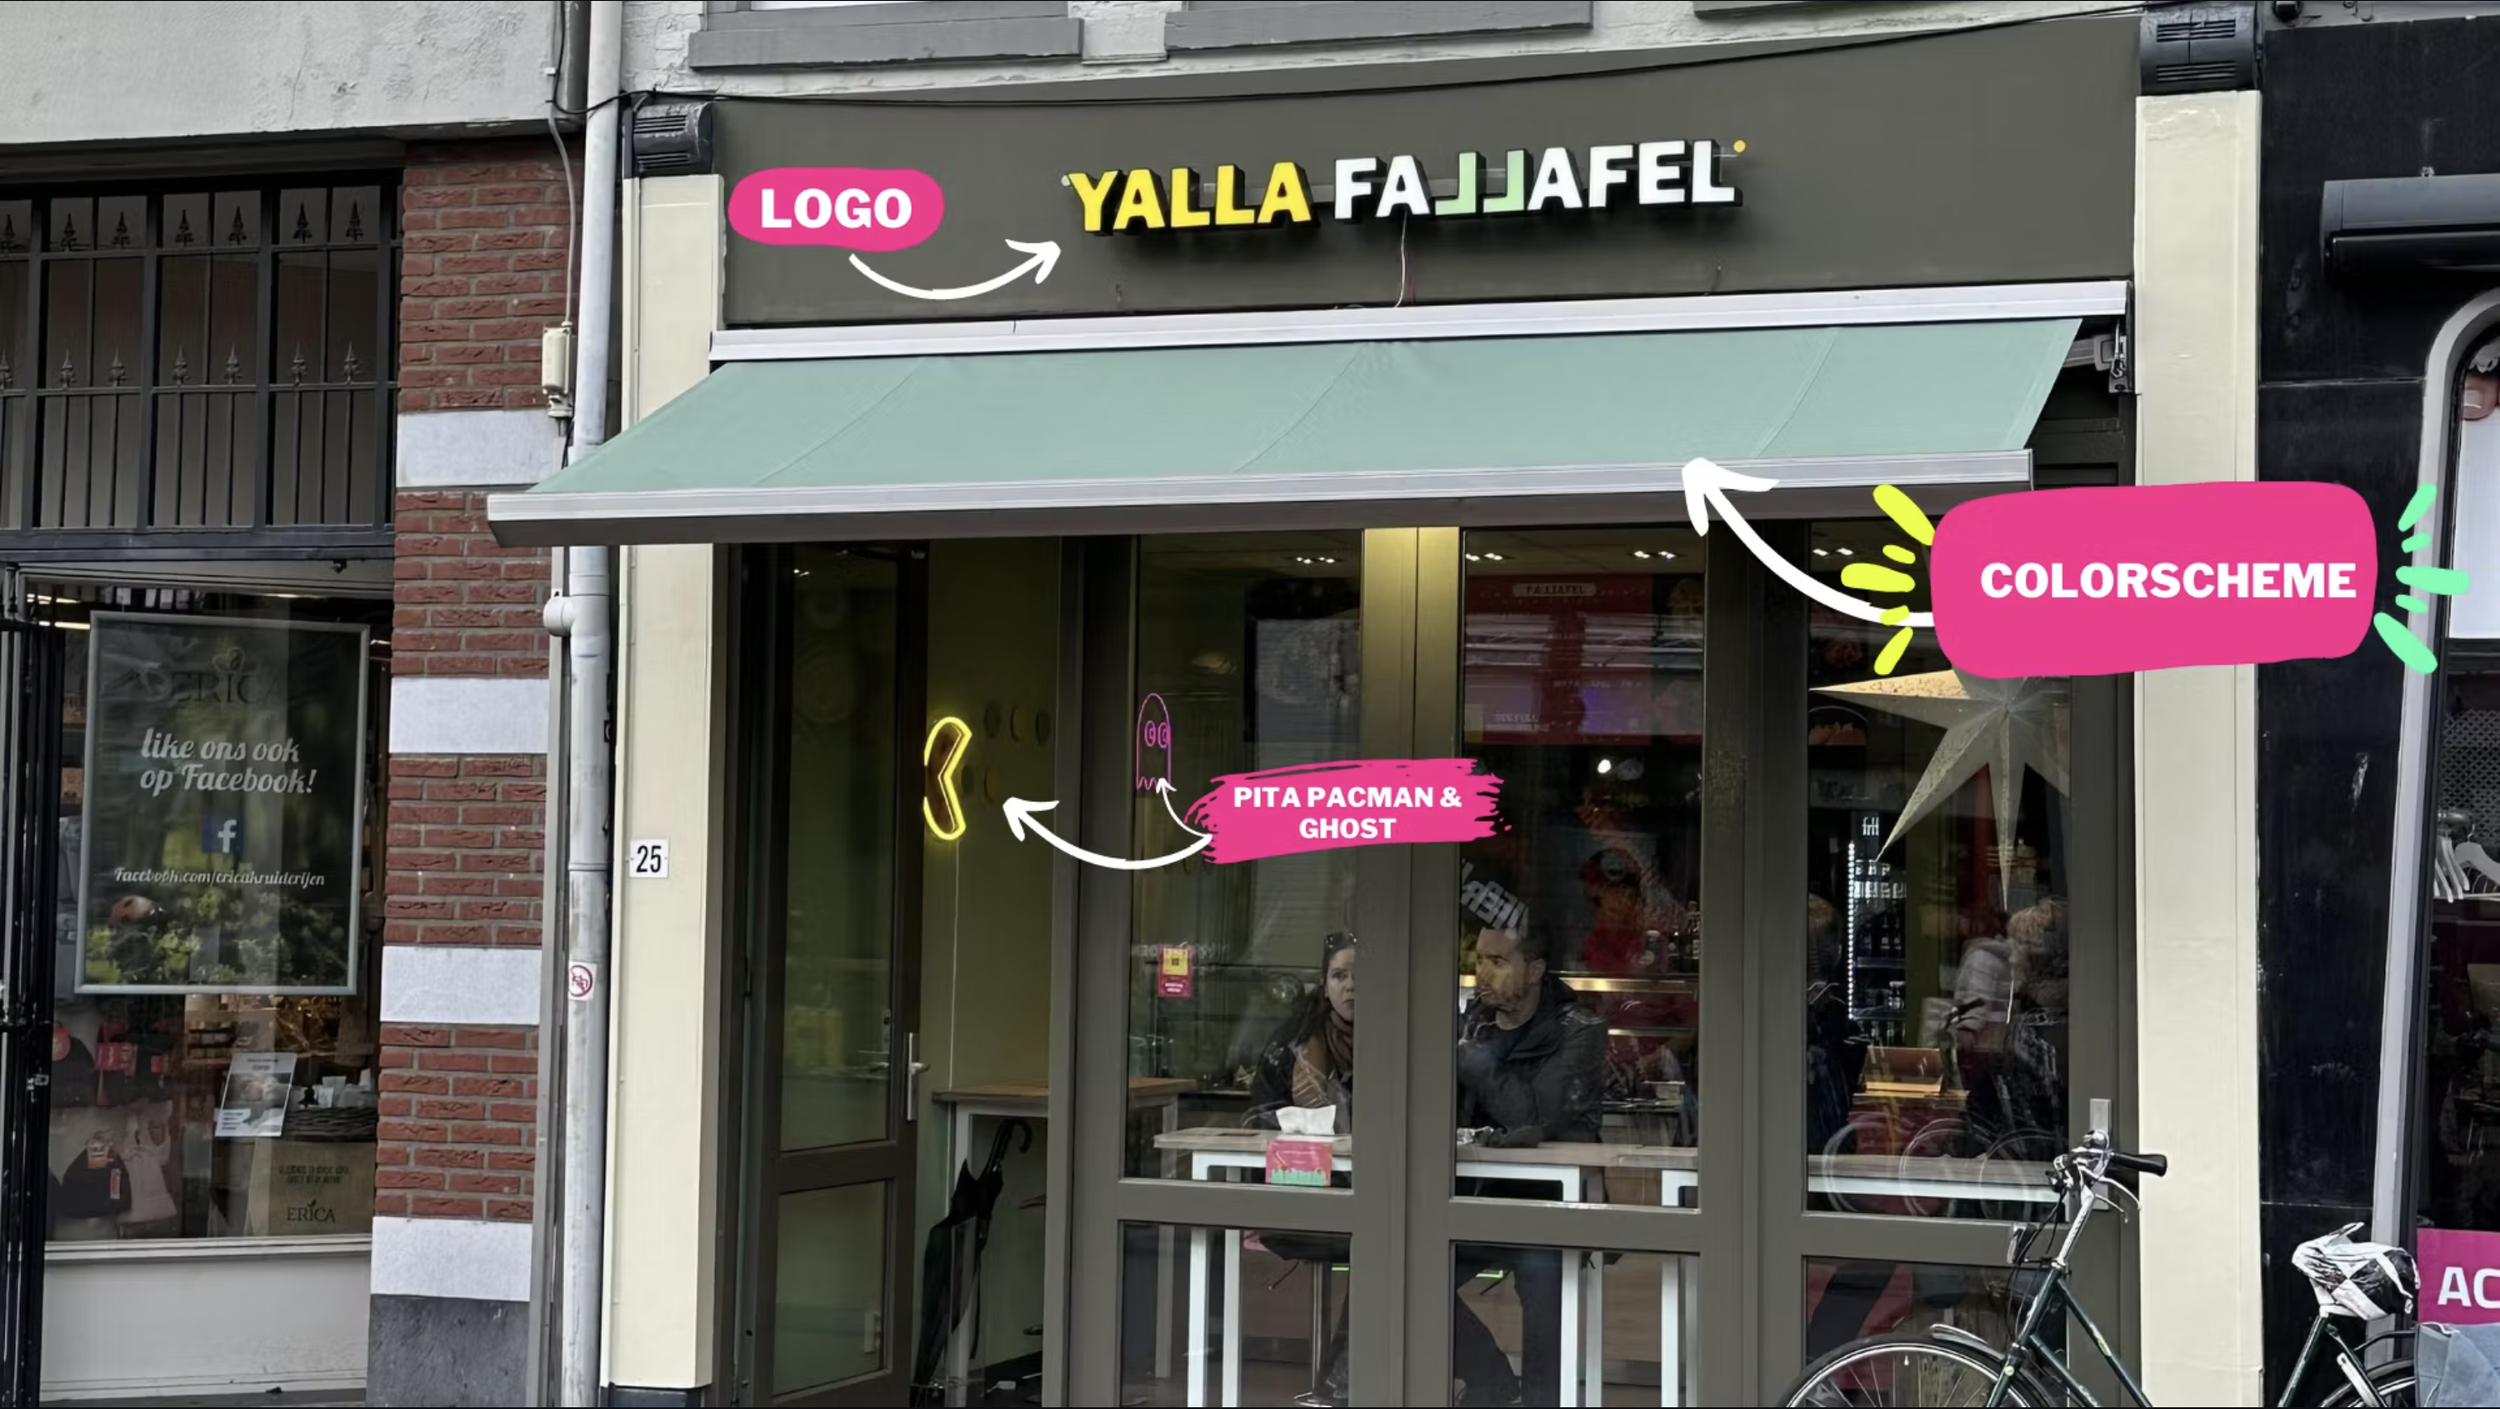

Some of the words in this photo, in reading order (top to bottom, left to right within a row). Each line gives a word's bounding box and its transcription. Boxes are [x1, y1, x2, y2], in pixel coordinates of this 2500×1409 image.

[1068, 161, 1312, 233] YALLA
[140, 728, 194, 759] like
[199, 740, 247, 761] ons
[252, 738, 300, 763] ook
[140, 769, 173, 797] op
[181, 763, 317, 794] Facebook!
[636, 845, 661, 873] 25
[287, 1206, 335, 1223] ERICA
